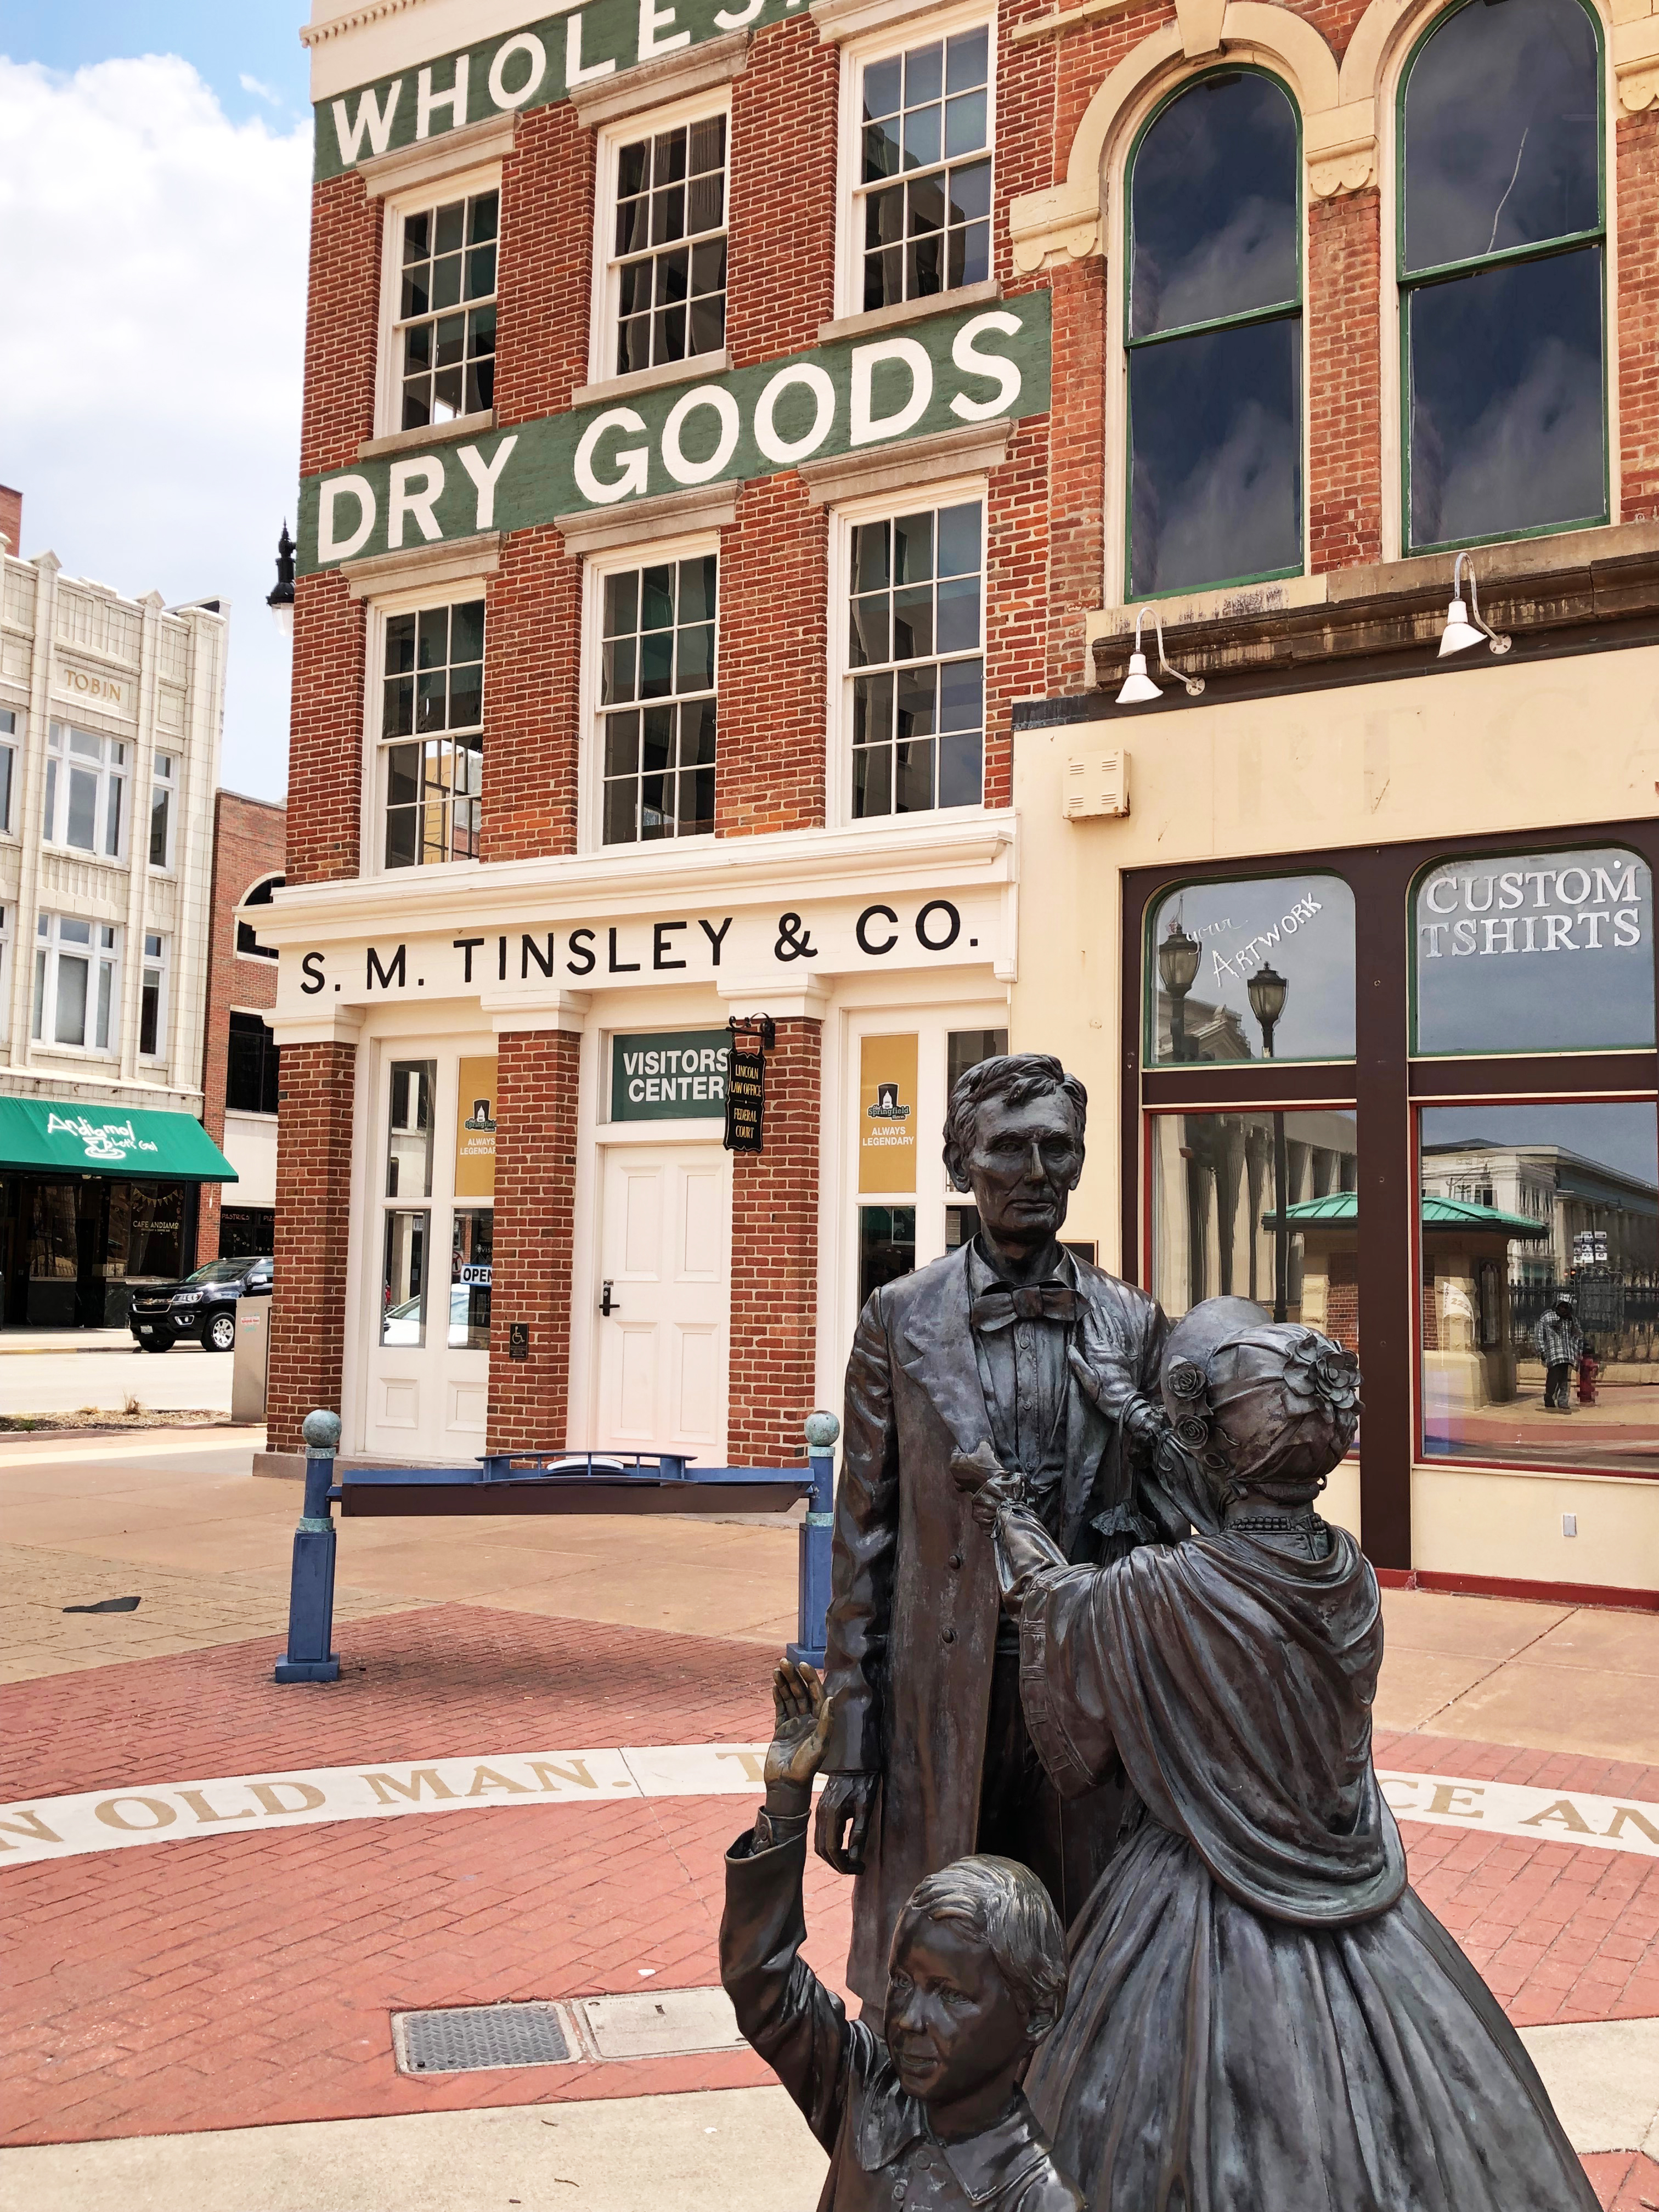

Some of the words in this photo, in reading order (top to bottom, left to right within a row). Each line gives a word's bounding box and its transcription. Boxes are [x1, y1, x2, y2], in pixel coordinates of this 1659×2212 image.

[332, 0, 800, 166] WHOLE
[318, 435, 518, 563] DRY
[573, 311, 1023, 504] GOODS
[65, 669, 121, 702] TOBIN
[1426, 865, 1642, 914] CUSTOM
[1420, 908, 1641, 958] TSHIRTS
[300, 951, 341, 994] S.
[366, 944, 424, 990] M.
[453, 917, 733, 983] TINSLEY
[774, 912, 819, 962] &
[856, 899, 978, 955] CO.
[623, 1047, 728, 1076] VISITORS
[735, 1064, 758, 1080] LINCOLN
[628, 1076, 724, 1103] CENTER
[731, 1081, 742, 1094] LAW
[743, 1084, 761, 1097] OFFICE
[733, 1108, 757, 1122] FEDERAL
[868, 1106, 909, 1116] Springfield
[467, 1137, 495, 1146] ALWAYS
[736, 1125, 754, 1139] COURT
[862, 1136, 914, 1146] LEGENDARY
[872, 1126, 906, 1136] ALWAYS
[460, 1146, 496, 1155] LEGENDAR
[94, 1781, 326, 1831] OLD
[358, 1758, 632, 1805] MAN.
